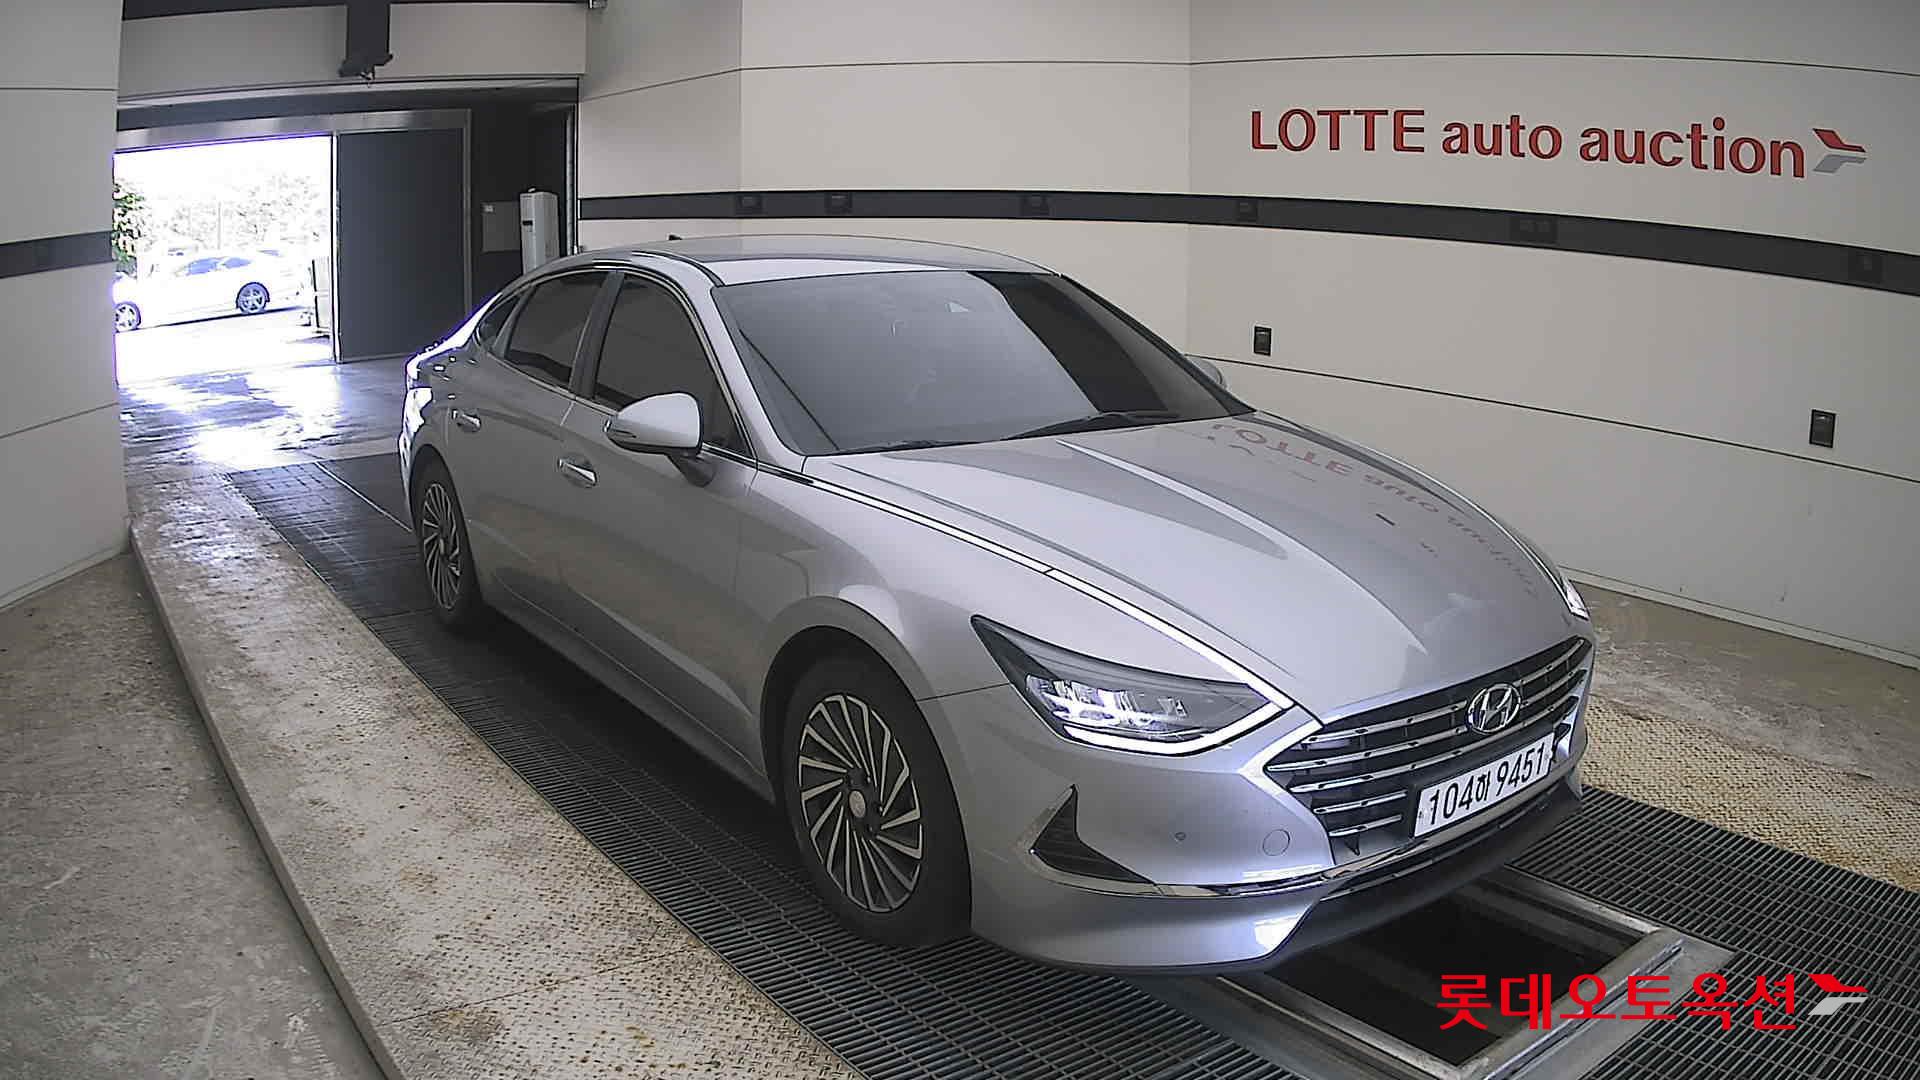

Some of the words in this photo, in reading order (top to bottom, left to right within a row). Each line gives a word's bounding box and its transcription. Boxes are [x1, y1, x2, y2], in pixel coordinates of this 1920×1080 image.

[1250, 109, 1425, 153] LOTTE
[1441, 115, 1563, 160] auto
[1578, 116, 1806, 179] auction
[1429, 770, 1491, 826] 104하
[1495, 741, 1546, 798] 9451
